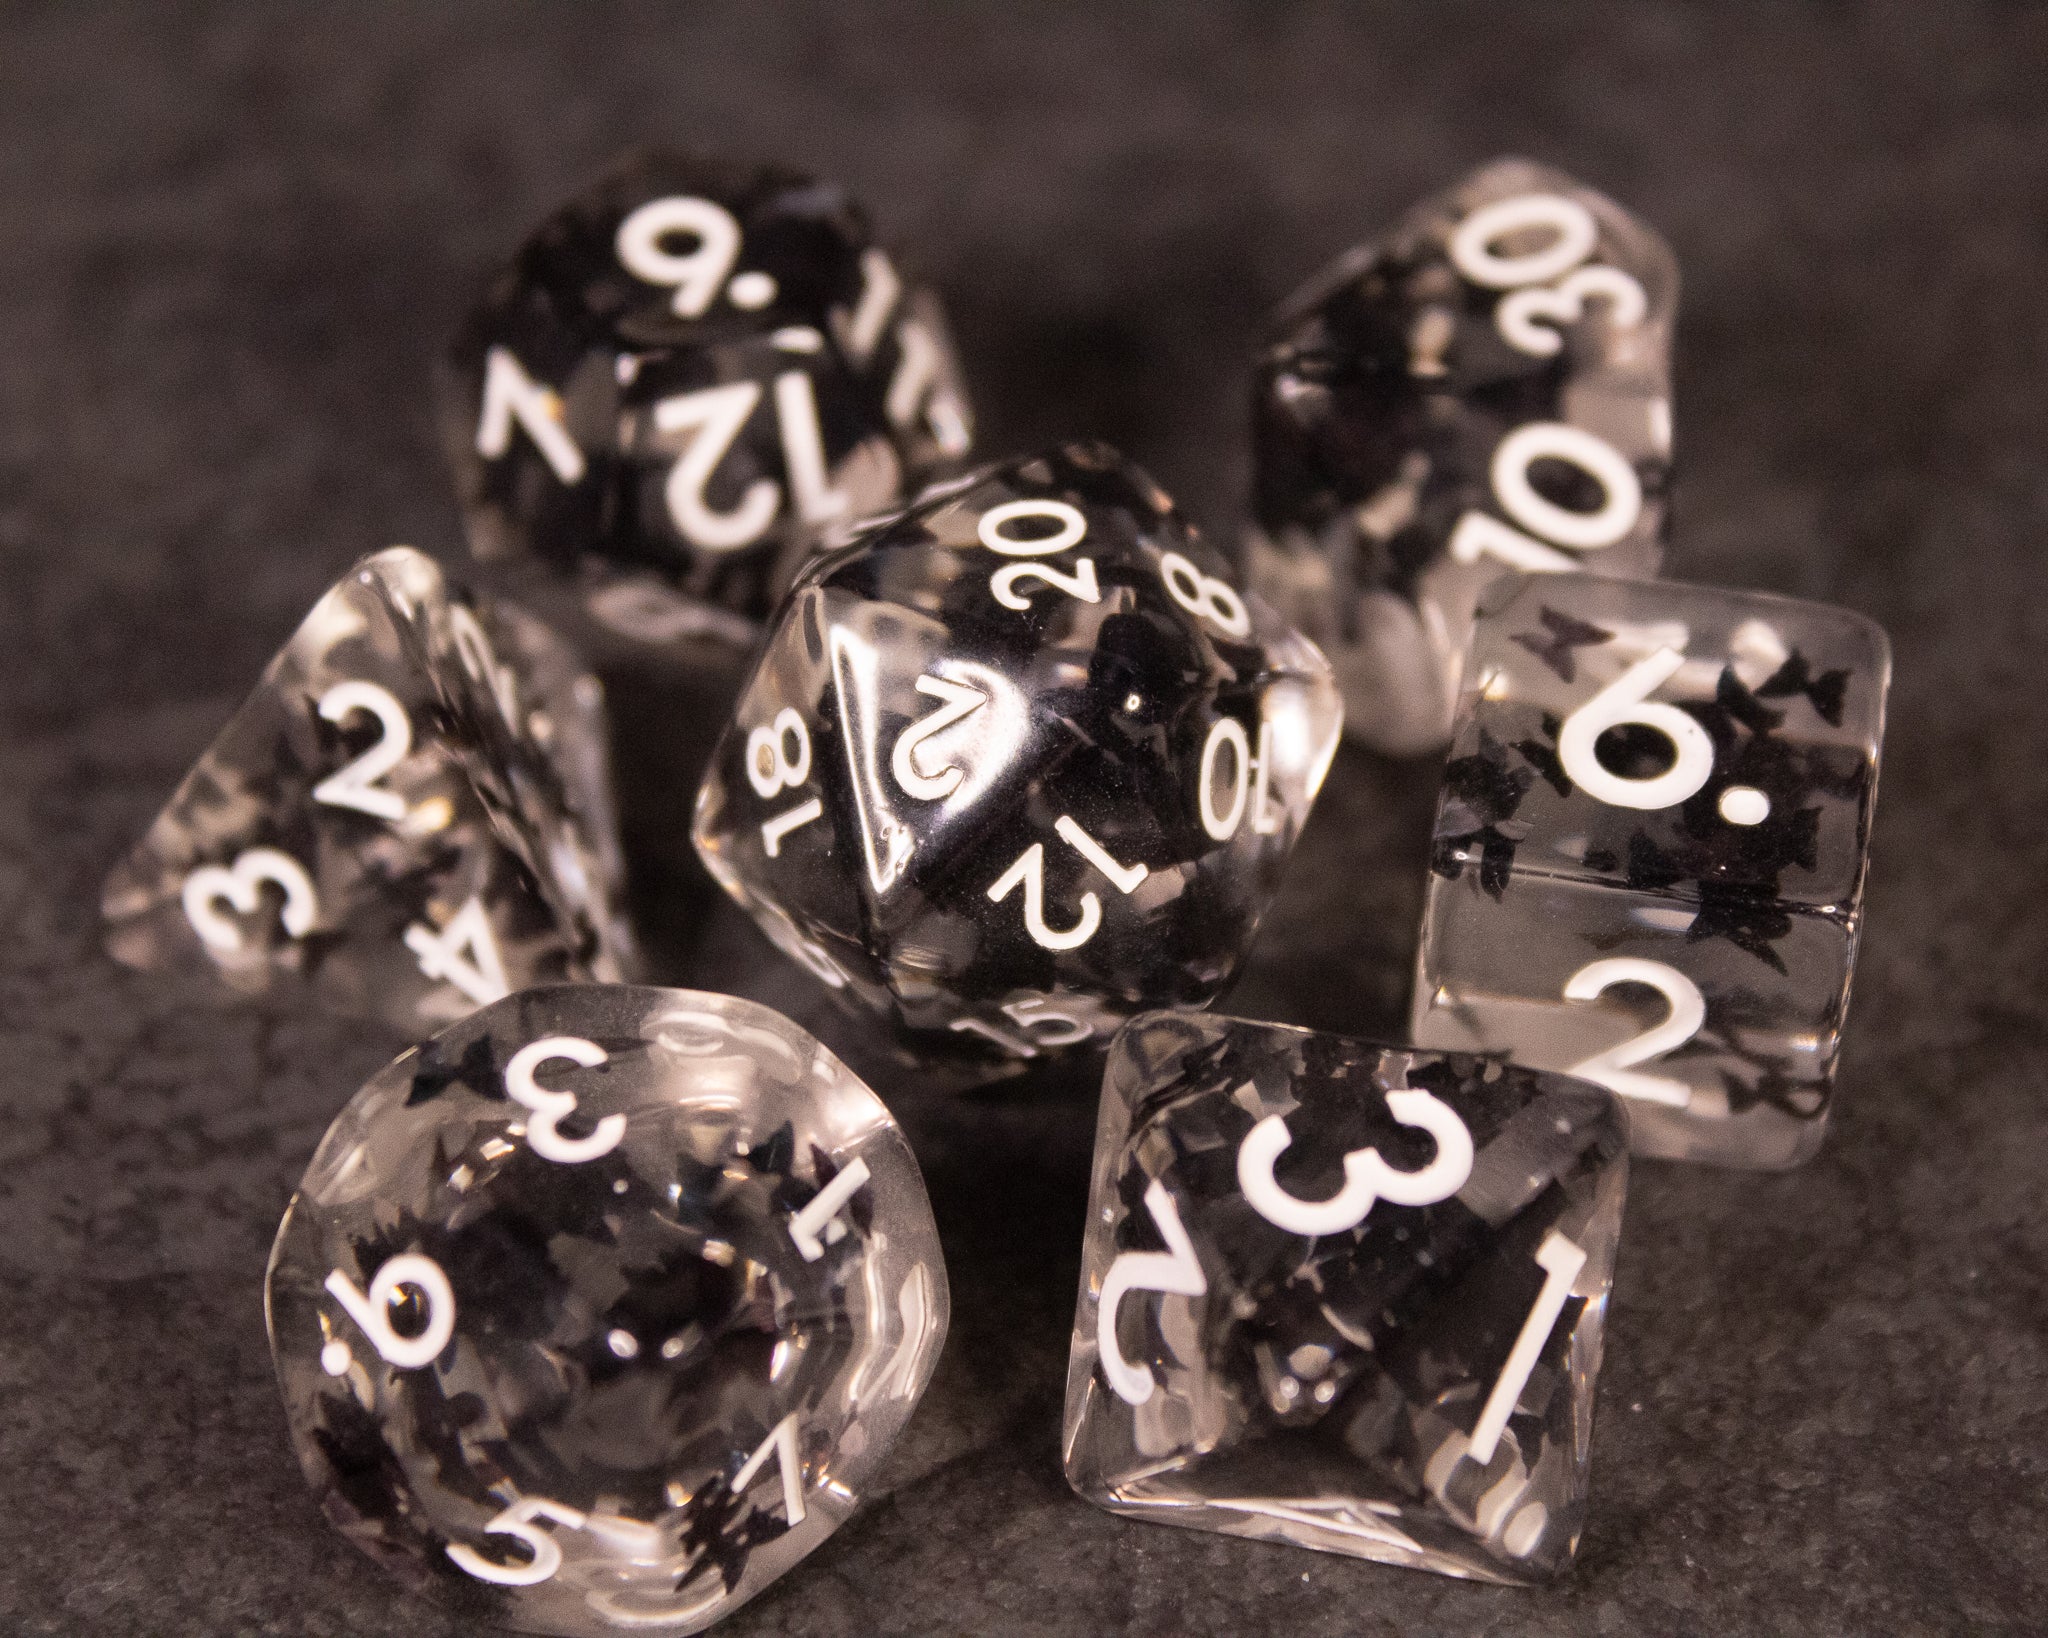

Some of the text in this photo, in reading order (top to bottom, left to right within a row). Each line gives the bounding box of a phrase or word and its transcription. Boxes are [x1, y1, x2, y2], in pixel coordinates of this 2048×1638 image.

[1450, 194, 1646, 357] 30
[978, 500, 1101, 611] 20
[1160, 552, 1251, 638] 8
[312, 682, 411, 822] 2
[747, 706, 822, 857] 18
[892, 674, 989, 801] 2
[1199, 716, 1276, 841] 10
[182, 846, 318, 952] 3
[986, 814, 1149, 951] 12
[404, 896, 510, 1008] 4
[949, 998, 1095, 1058] 15
[1563, 956, 1706, 1108] 2
[505, 1036, 627, 1164] 3
[1237, 1088, 1475, 1237] 3
[788, 1155, 872, 1264] 1
[1099, 1178, 1208, 1407] 2
[1468, 1230, 1588, 1466] 1
[445, 1497, 587, 1586] 5
